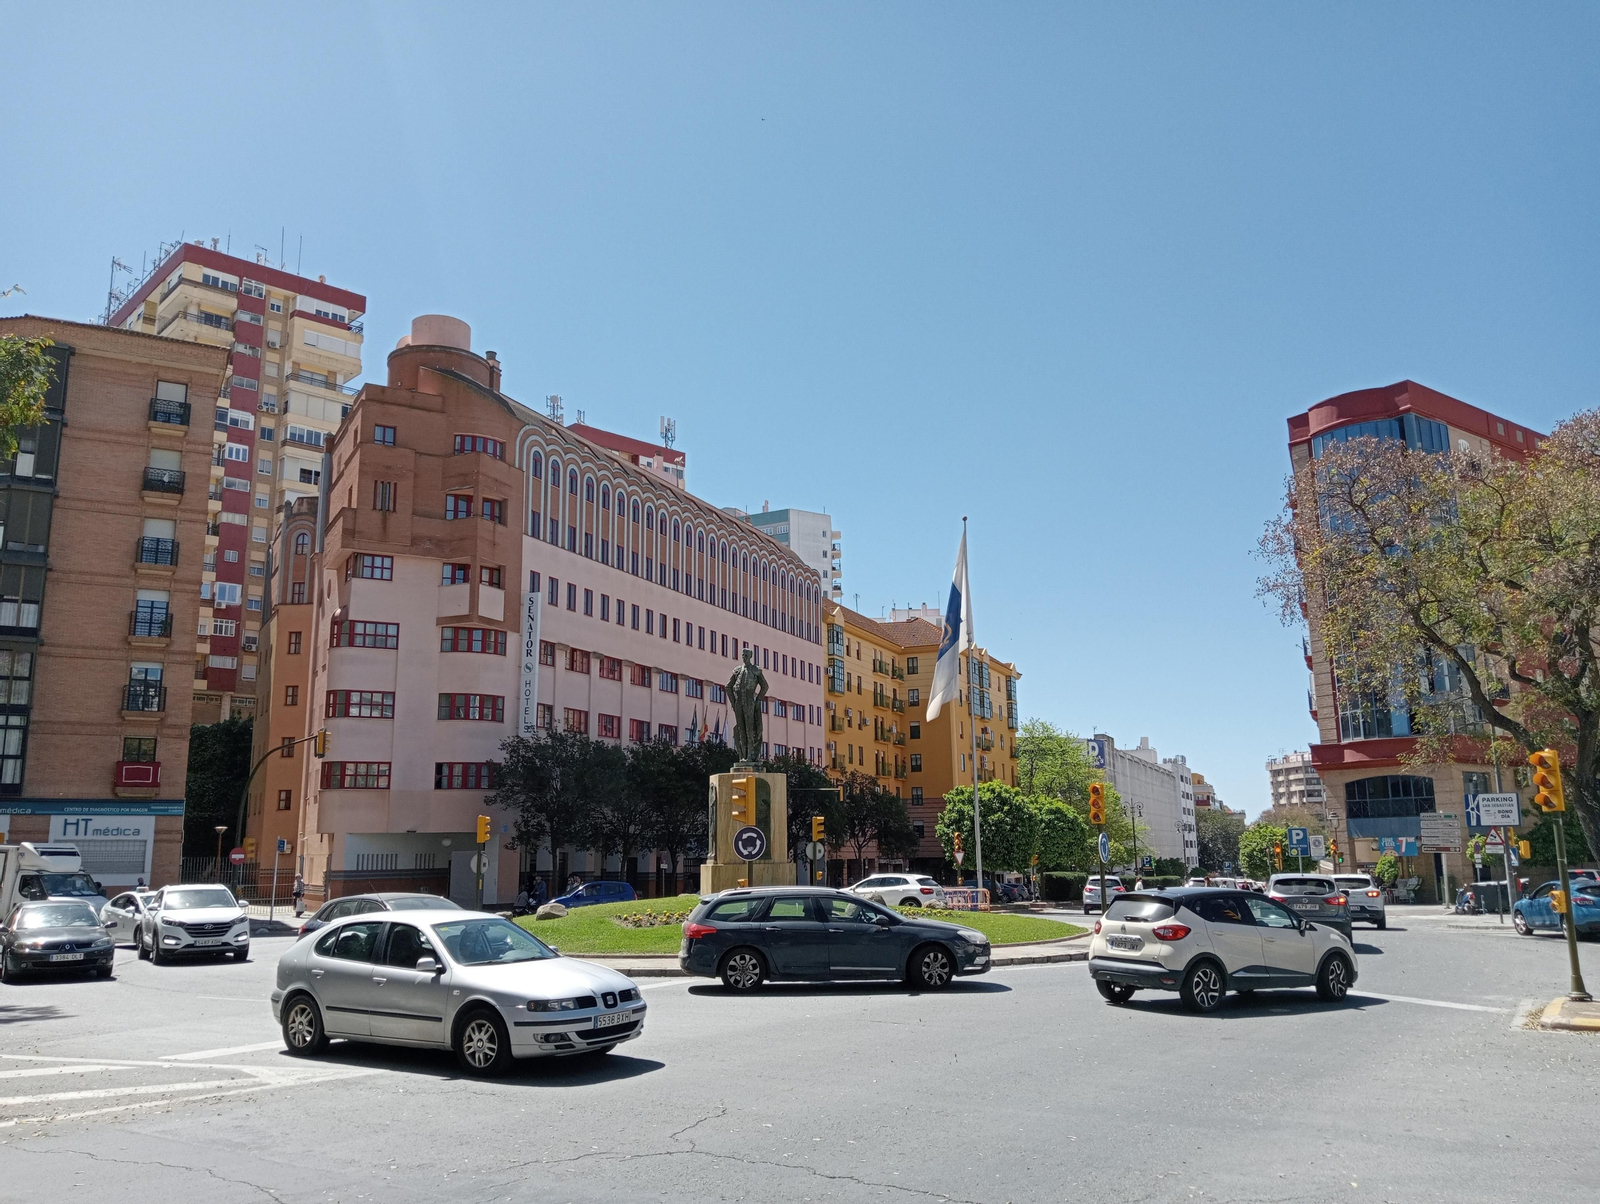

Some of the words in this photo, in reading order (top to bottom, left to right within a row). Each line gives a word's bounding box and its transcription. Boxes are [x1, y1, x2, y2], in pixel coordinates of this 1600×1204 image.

[526, 597, 534, 657] SENATOR
[523, 680, 531, 724] HOTEL
[63, 818, 93, 836] HT
[92, 826, 141, 836] médica
[1291, 829, 1304, 844] P
[1144, 857, 1150, 865] P
[598, 1016, 615, 1026] 5538
[616, 1013, 629, 1023] BXH
